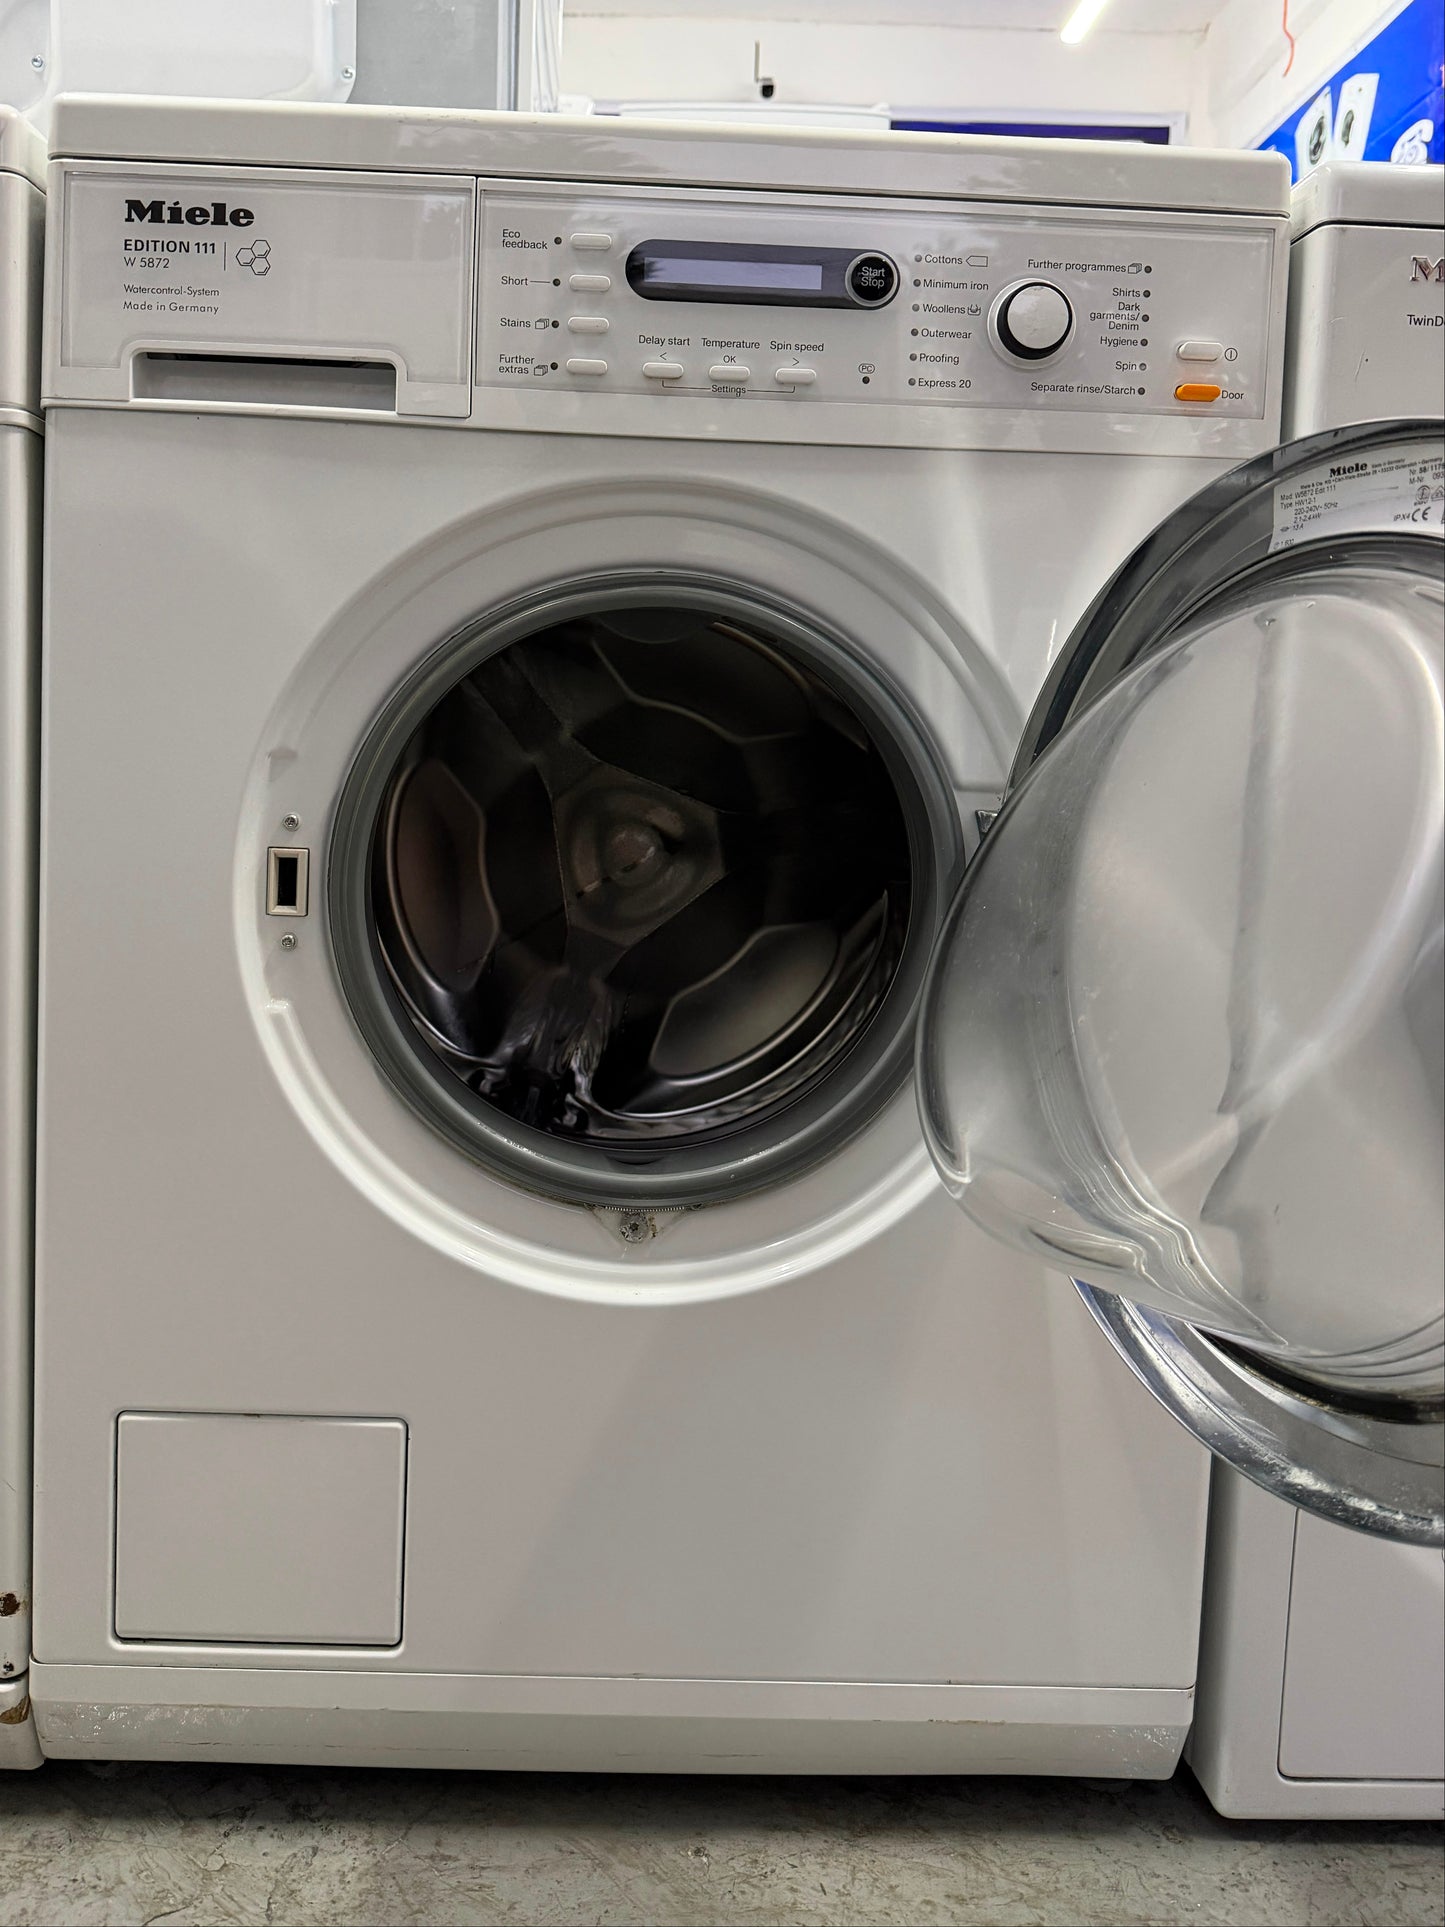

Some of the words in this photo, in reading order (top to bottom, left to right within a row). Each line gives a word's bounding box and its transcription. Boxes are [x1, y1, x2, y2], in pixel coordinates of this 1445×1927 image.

[124, 199, 255, 226] Miele
[502, 229, 521, 240] Eco
[123, 239, 190, 254] EDITION
[194, 241, 216, 255] 111
[502, 238, 548, 250] feedback
[124, 256, 136, 268] W
[139, 257, 170, 270] 5872
[924, 254, 963, 266] Cottons
[1028, 258, 1063, 270] Further
[1065, 260, 1127, 273] programmes
[861, 265, 886, 278] Start
[501, 275, 529, 287] Short
[860, 276, 886, 289] Stop
[923, 278, 968, 290] Minimum
[969, 280, 989, 291] iron
[123, 283, 220, 297] Watercontrol-System
[1112, 287, 1141, 298] Shirts
[123, 300, 153, 313] Made
[156, 301, 166, 313] in
[168, 302, 219, 315] Germany
[922, 303, 966, 315] Woollens
[1118, 301, 1141, 312] Dark
[500, 317, 531, 329] Stains
[1089, 311, 1140, 323] garments/
[1108, 321, 1140, 332] Denim
[920, 327, 972, 340] Outerwear
[638, 334, 665, 347] Delay
[667, 336, 691, 347] start
[700, 337, 761, 352] Temperature
[769, 340, 792, 352] Spin
[793, 341, 824, 354] speed
[1100, 336, 1139, 349] Hygiene
[499, 354, 535, 366] Further
[723, 354, 737, 365] OK
[919, 352, 960, 365] Proofing
[498, 364, 529, 375] extras
[1115, 361, 1137, 373] Spin
[711, 384, 747, 398] Settings
[918, 378, 956, 391] Express
[958, 379, 972, 390] 20
[1030, 382, 1074, 395] Separate
[1076, 383, 1136, 396] rinse/Starch
[1221, 389, 1245, 401] Door
[1329, 462, 1368, 478] Miele
